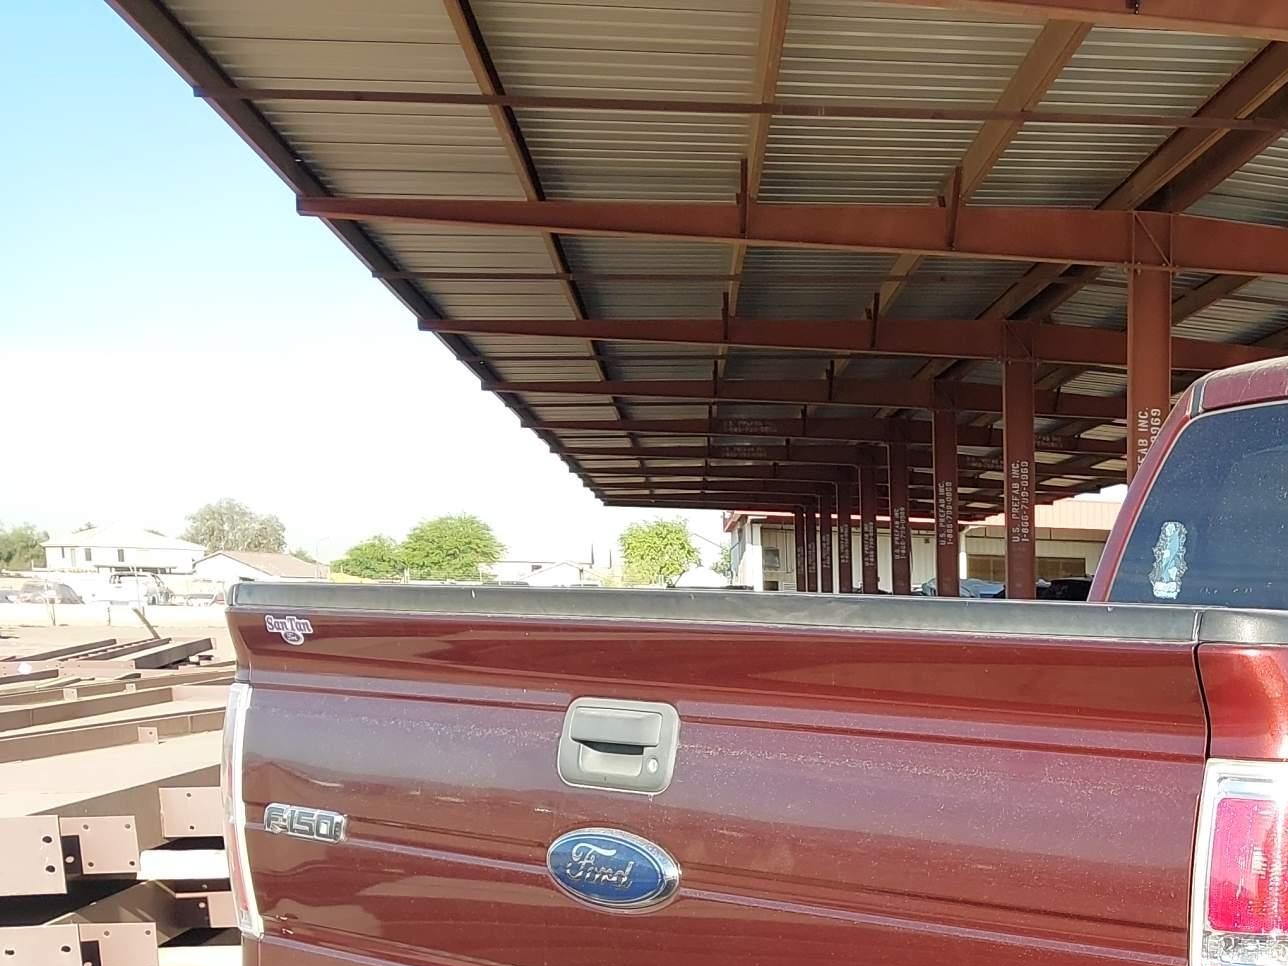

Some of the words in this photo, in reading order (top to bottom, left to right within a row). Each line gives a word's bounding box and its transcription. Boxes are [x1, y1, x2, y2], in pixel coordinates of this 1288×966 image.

[1138, 407, 1149, 432] INC.
[1011, 482, 1020, 519] PREFAB
[267, 616, 288, 631] San
[286, 616, 312, 633] Tan
[565, 842, 635, 891] Ford
